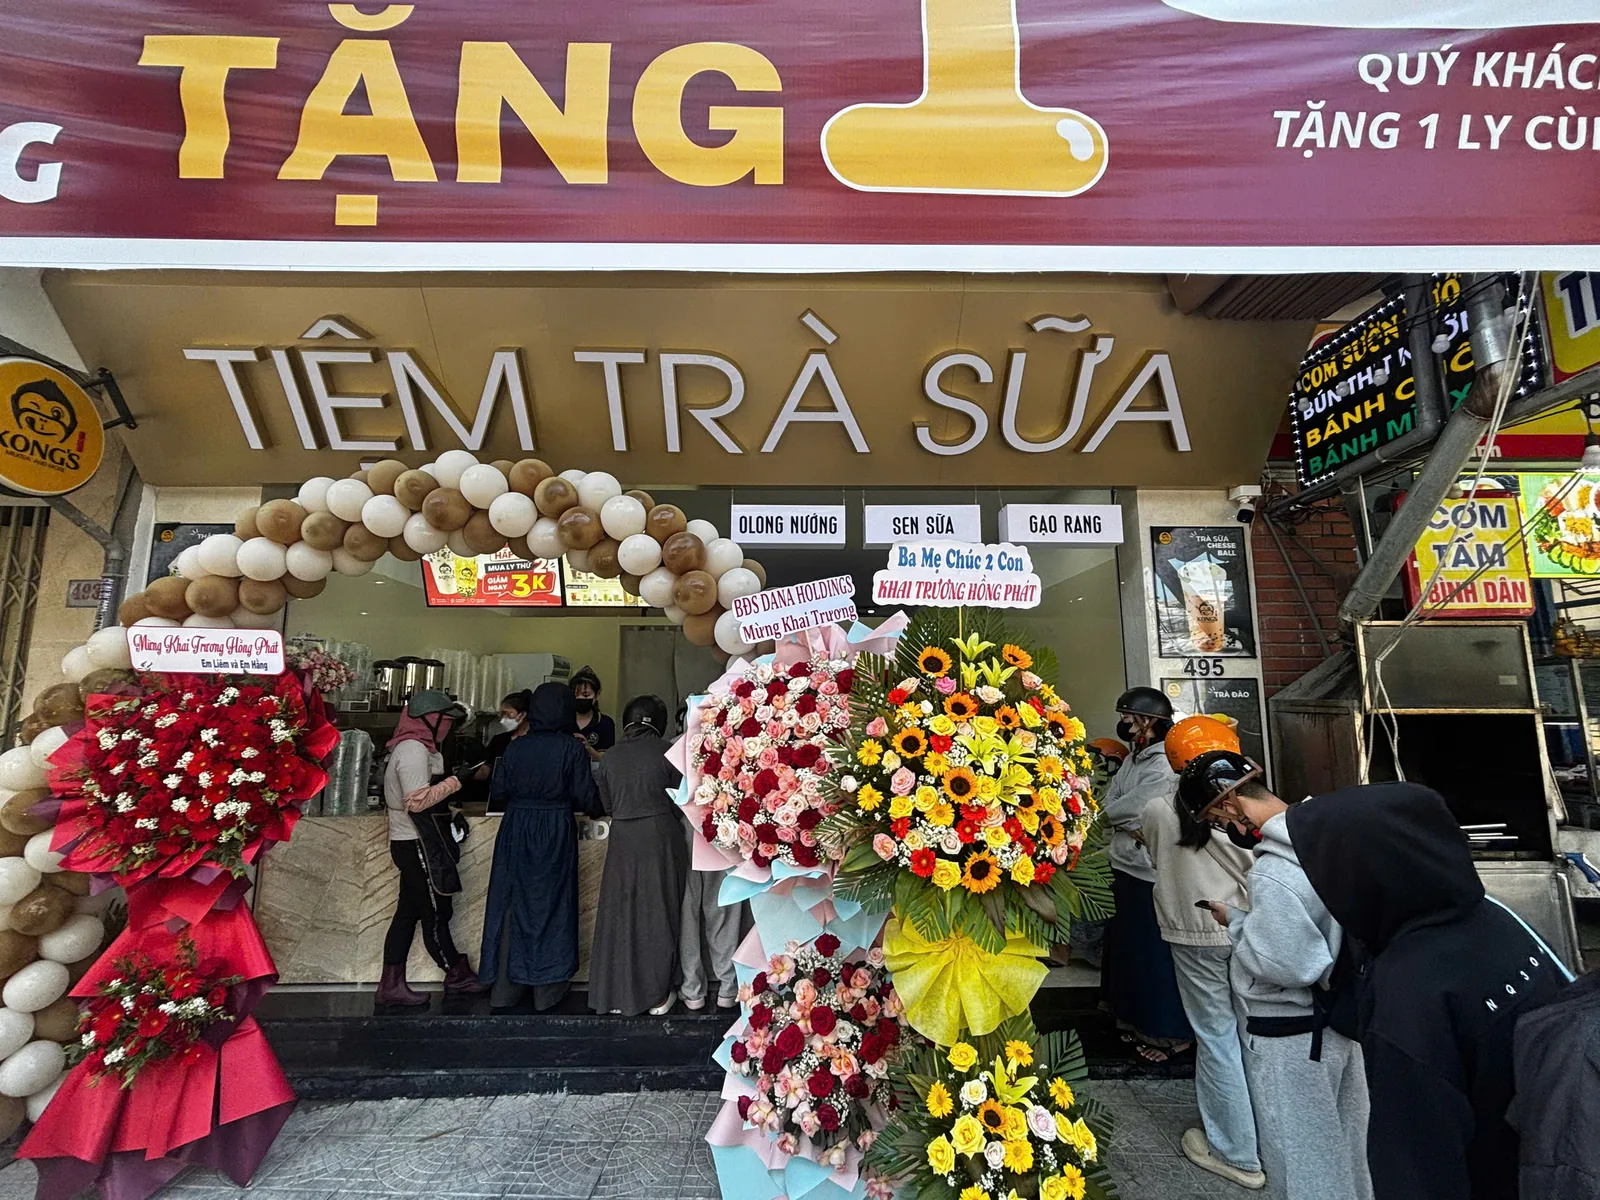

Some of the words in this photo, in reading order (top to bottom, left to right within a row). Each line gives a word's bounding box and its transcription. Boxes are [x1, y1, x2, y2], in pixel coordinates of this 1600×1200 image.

[1358, 44, 1460, 92] QUÝ
[1472, 43, 1600, 90] KHÁC
[138, 4, 784, 226] TẶNG
[1273, 100, 1401, 158] TẶNG
[1418, 113, 1440, 149] 1
[1458, 114, 1512, 150] LY
[1525, 106, 1600, 150] CÙ
[1347, 353, 1392, 395] THT
[182, 315, 540, 471] TIỆM
[574, 309, 873, 455] TRÀ
[914, 314, 1192, 456] SỮA
[1306, 393, 1386, 448] BÁNH
[1309, 428, 1378, 476] BÁNH
[738, 516, 783, 534] OLONG
[790, 514, 838, 534] NƯỚNG
[892, 516, 920, 535] SEN
[926, 514, 955, 535] SỮA
[1029, 515, 1057, 537] GẠO
[1063, 515, 1101, 534] RANG
[1429, 502, 1507, 530] CƠM
[1196, 533, 1211, 542] TRÀ
[1433, 532, 1505, 568] TẤM
[488, 564, 505, 572] MUA
[506, 563, 515, 571] LY
[533, 558, 548, 573] 2
[898, 546, 916, 567] Ba
[921, 547, 941, 574] Mẹ
[946, 549, 982, 570] Chúc
[985, 553, 994, 571] 2
[997, 551, 1024, 571] Con
[734, 595, 760, 618] BĐS
[760, 588, 795, 612] DANA
[795, 575, 853, 604] HOLDINGS
[877, 580, 912, 599] KHAI
[915, 578, 966, 600] TRƯƠNG
[967, 575, 1002, 601] HỒNG
[1003, 580, 1037, 602] PHÁT
[1428, 577, 1477, 603] BÌNH
[1484, 577, 1527, 603] DÂN
[742, 621, 782, 642] Mừng
[781, 612, 811, 632] Khai
[811, 605, 858, 626] Trương
[133, 634, 162, 655] Mừng
[164, 634, 190, 654] Khai
[225, 636, 253, 657] Hồng
[254, 637, 279, 655] Phát
[201, 659, 212, 668] Em
[230, 659, 239, 669] và
[240, 660, 250, 669] Em
[1183, 659, 1225, 677] 495
[1214, 688, 1231, 698] TRÀ
[1231, 688, 1250, 698] ĐÀO
